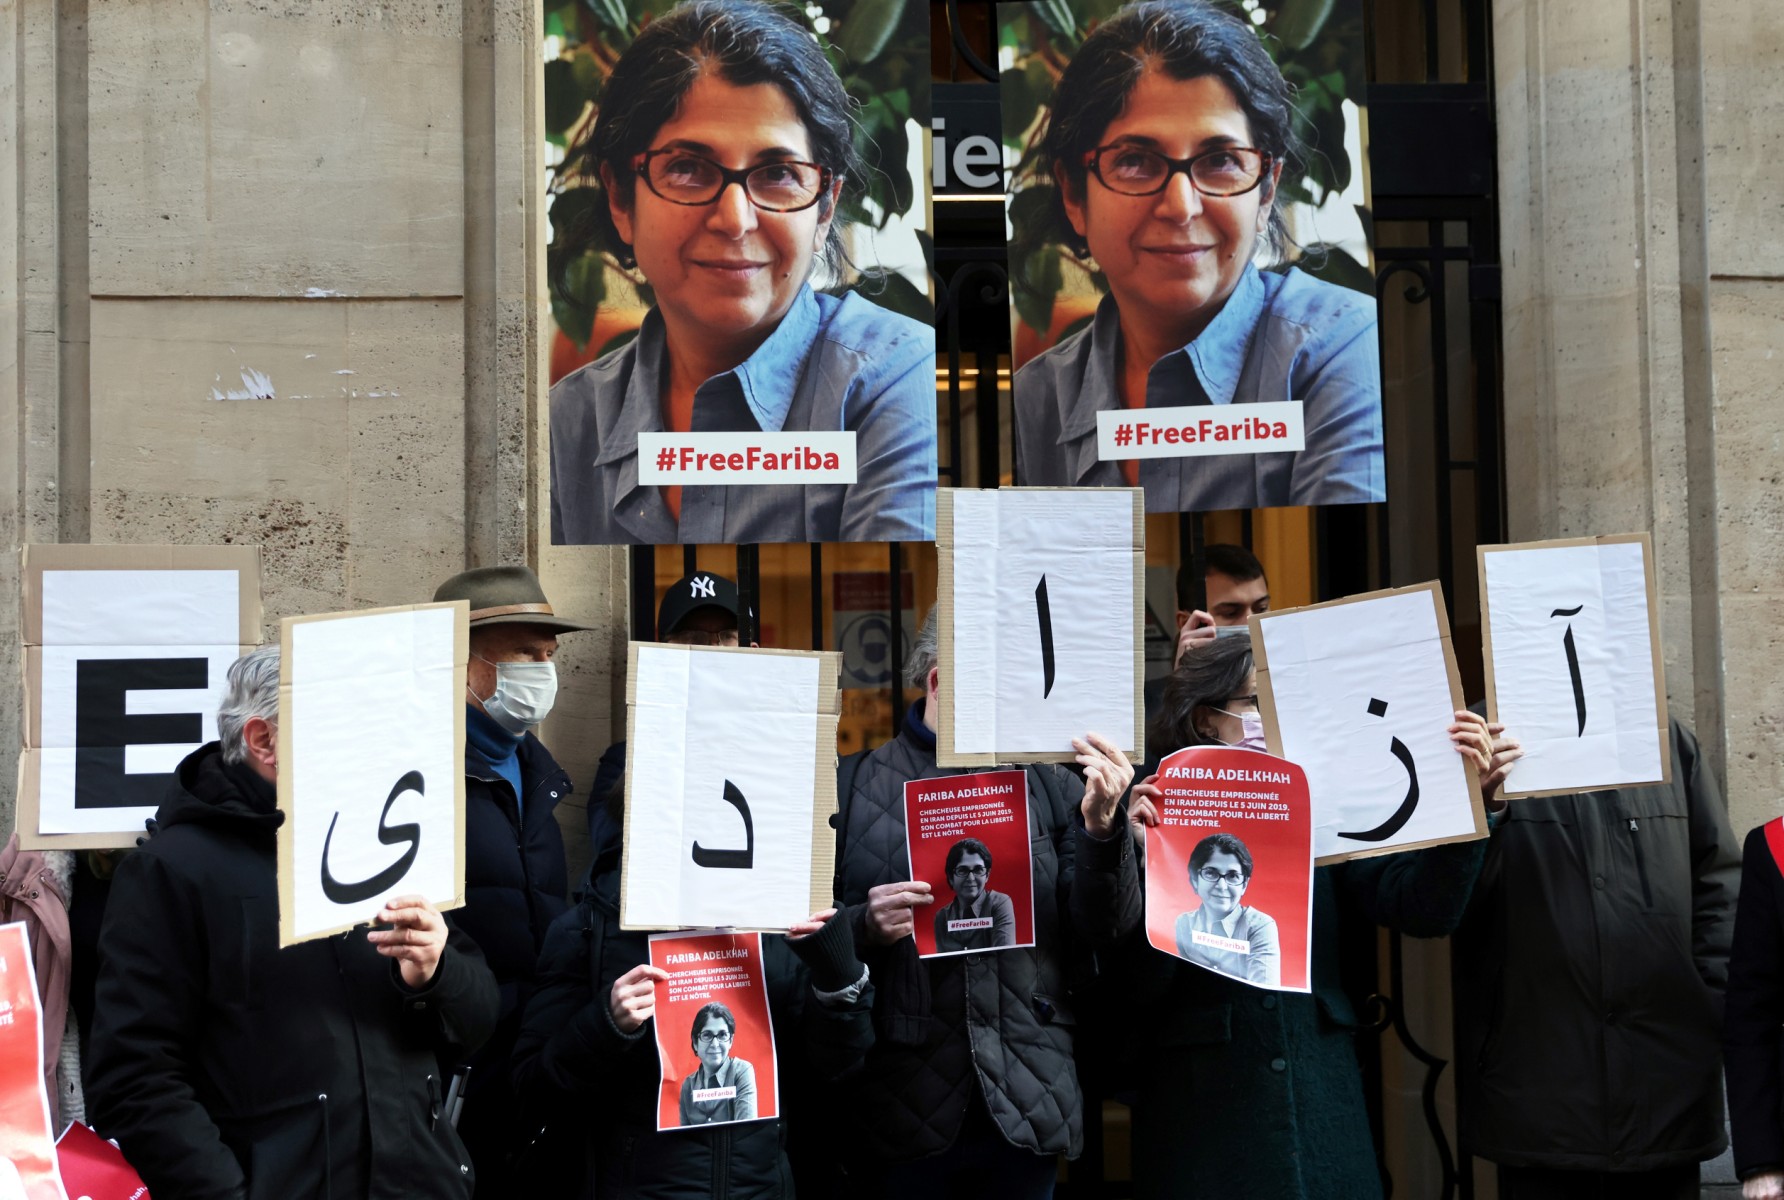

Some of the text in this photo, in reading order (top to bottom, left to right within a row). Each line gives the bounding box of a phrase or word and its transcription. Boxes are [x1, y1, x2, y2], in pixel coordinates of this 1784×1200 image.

[1114, 415, 1288, 447] #FreeFariba
[656, 447, 840, 472] #FreeFariba
[690, 576, 716, 598] NY
[74, 657, 208, 809] E
[1165, 767, 1290, 784] FARIBA ADELKHAH
[918, 785, 1012, 802] FARIBA ADELKHAH
[1165, 789, 1279, 800] CHERCHEUSE EMPRISONNÉE
[920, 802, 1004, 816] CHERCHEUSE EMPRISONNÉE
[990, 816, 1013, 824] LIBERTÉ
[1191, 817, 1220, 827] NÔTRE.
[951, 920, 990, 928] #FreeFariba
[1197, 935, 1245, 950] #FreeFariba
[666, 949, 748, 964] FARIBA ADELKHAH
[669, 969, 706, 978] CHERCHEUSE
[697, 1090, 734, 1098] #FreeFariba
